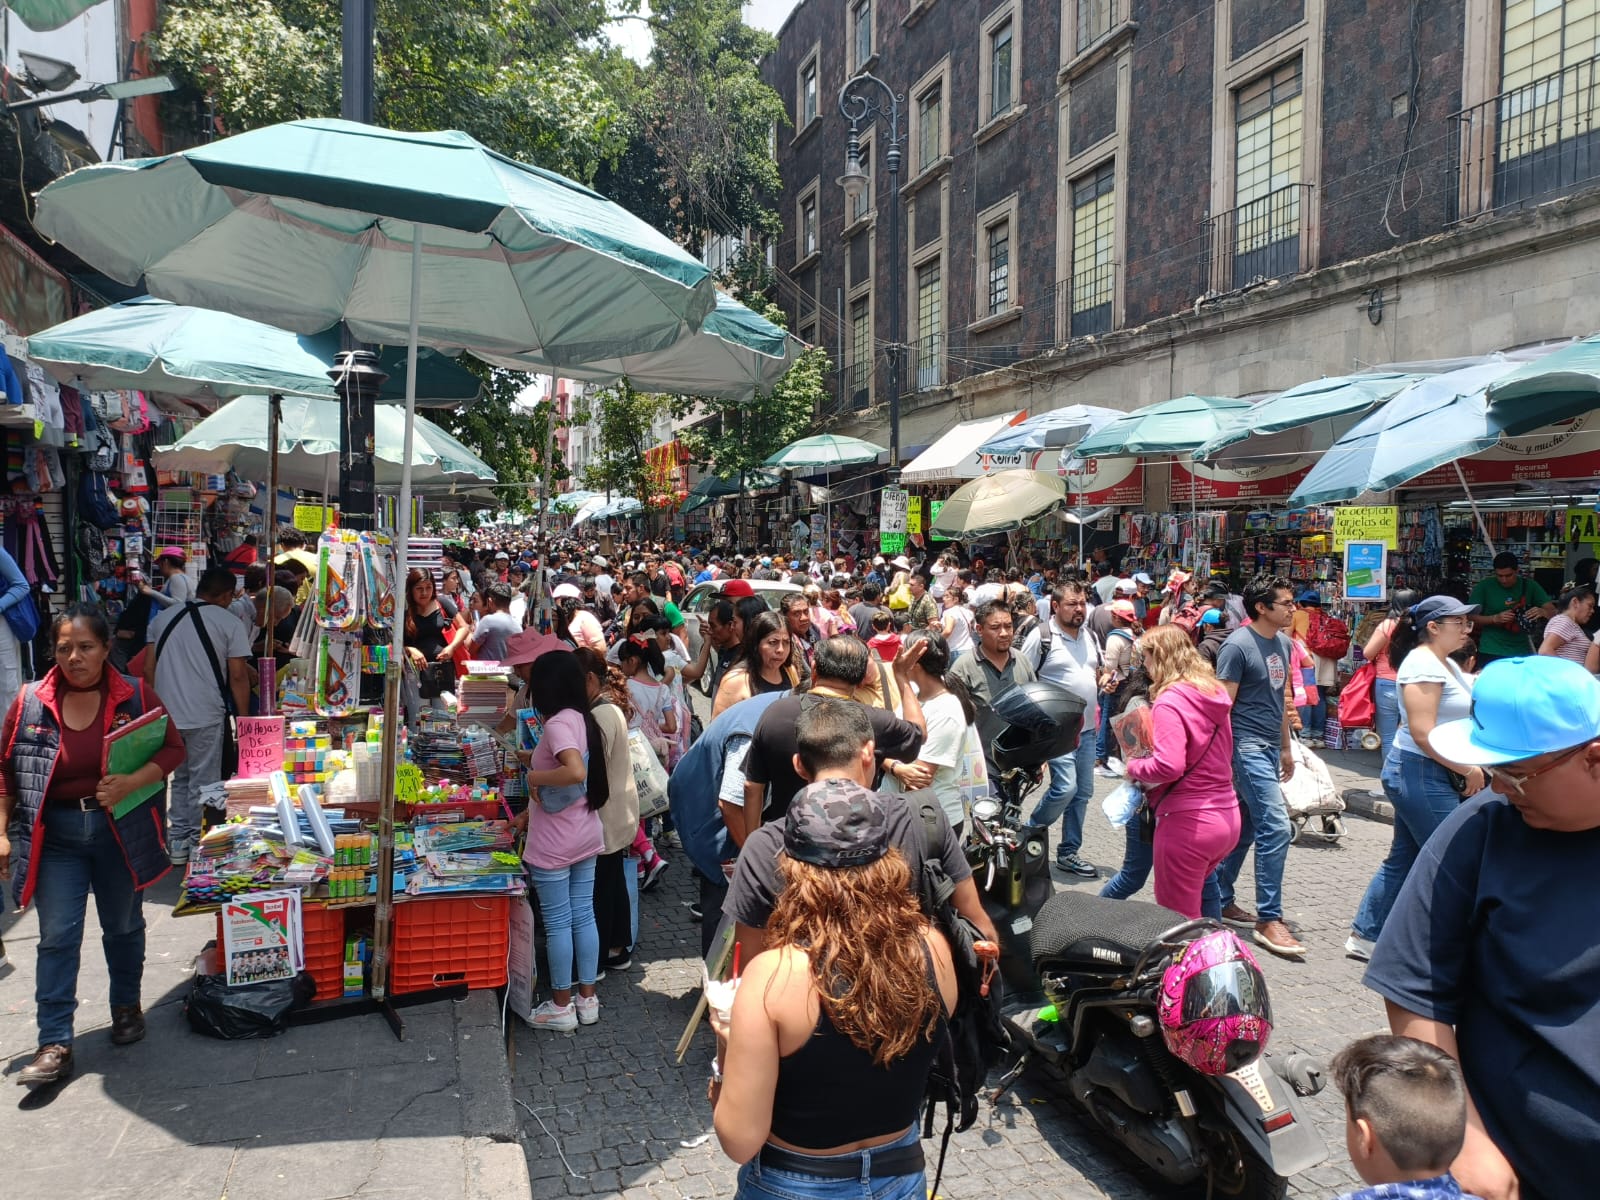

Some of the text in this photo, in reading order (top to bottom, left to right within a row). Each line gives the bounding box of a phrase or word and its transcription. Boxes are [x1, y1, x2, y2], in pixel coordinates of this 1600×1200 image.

[1525, 445, 1532, 455] y
[1535, 434, 1564, 451] mucho
[1515, 463, 1548, 471] Sucursal
[1512, 471, 1551, 480] MESONES
[884, 491, 907, 501] OFERTA
[1380, 516, 1392, 526] de
[254, 721, 281, 736] Hojas
[249, 737, 264, 748] DE
[241, 748, 272, 760] COLOR
[1092, 946, 1122, 964] YAMAHA
